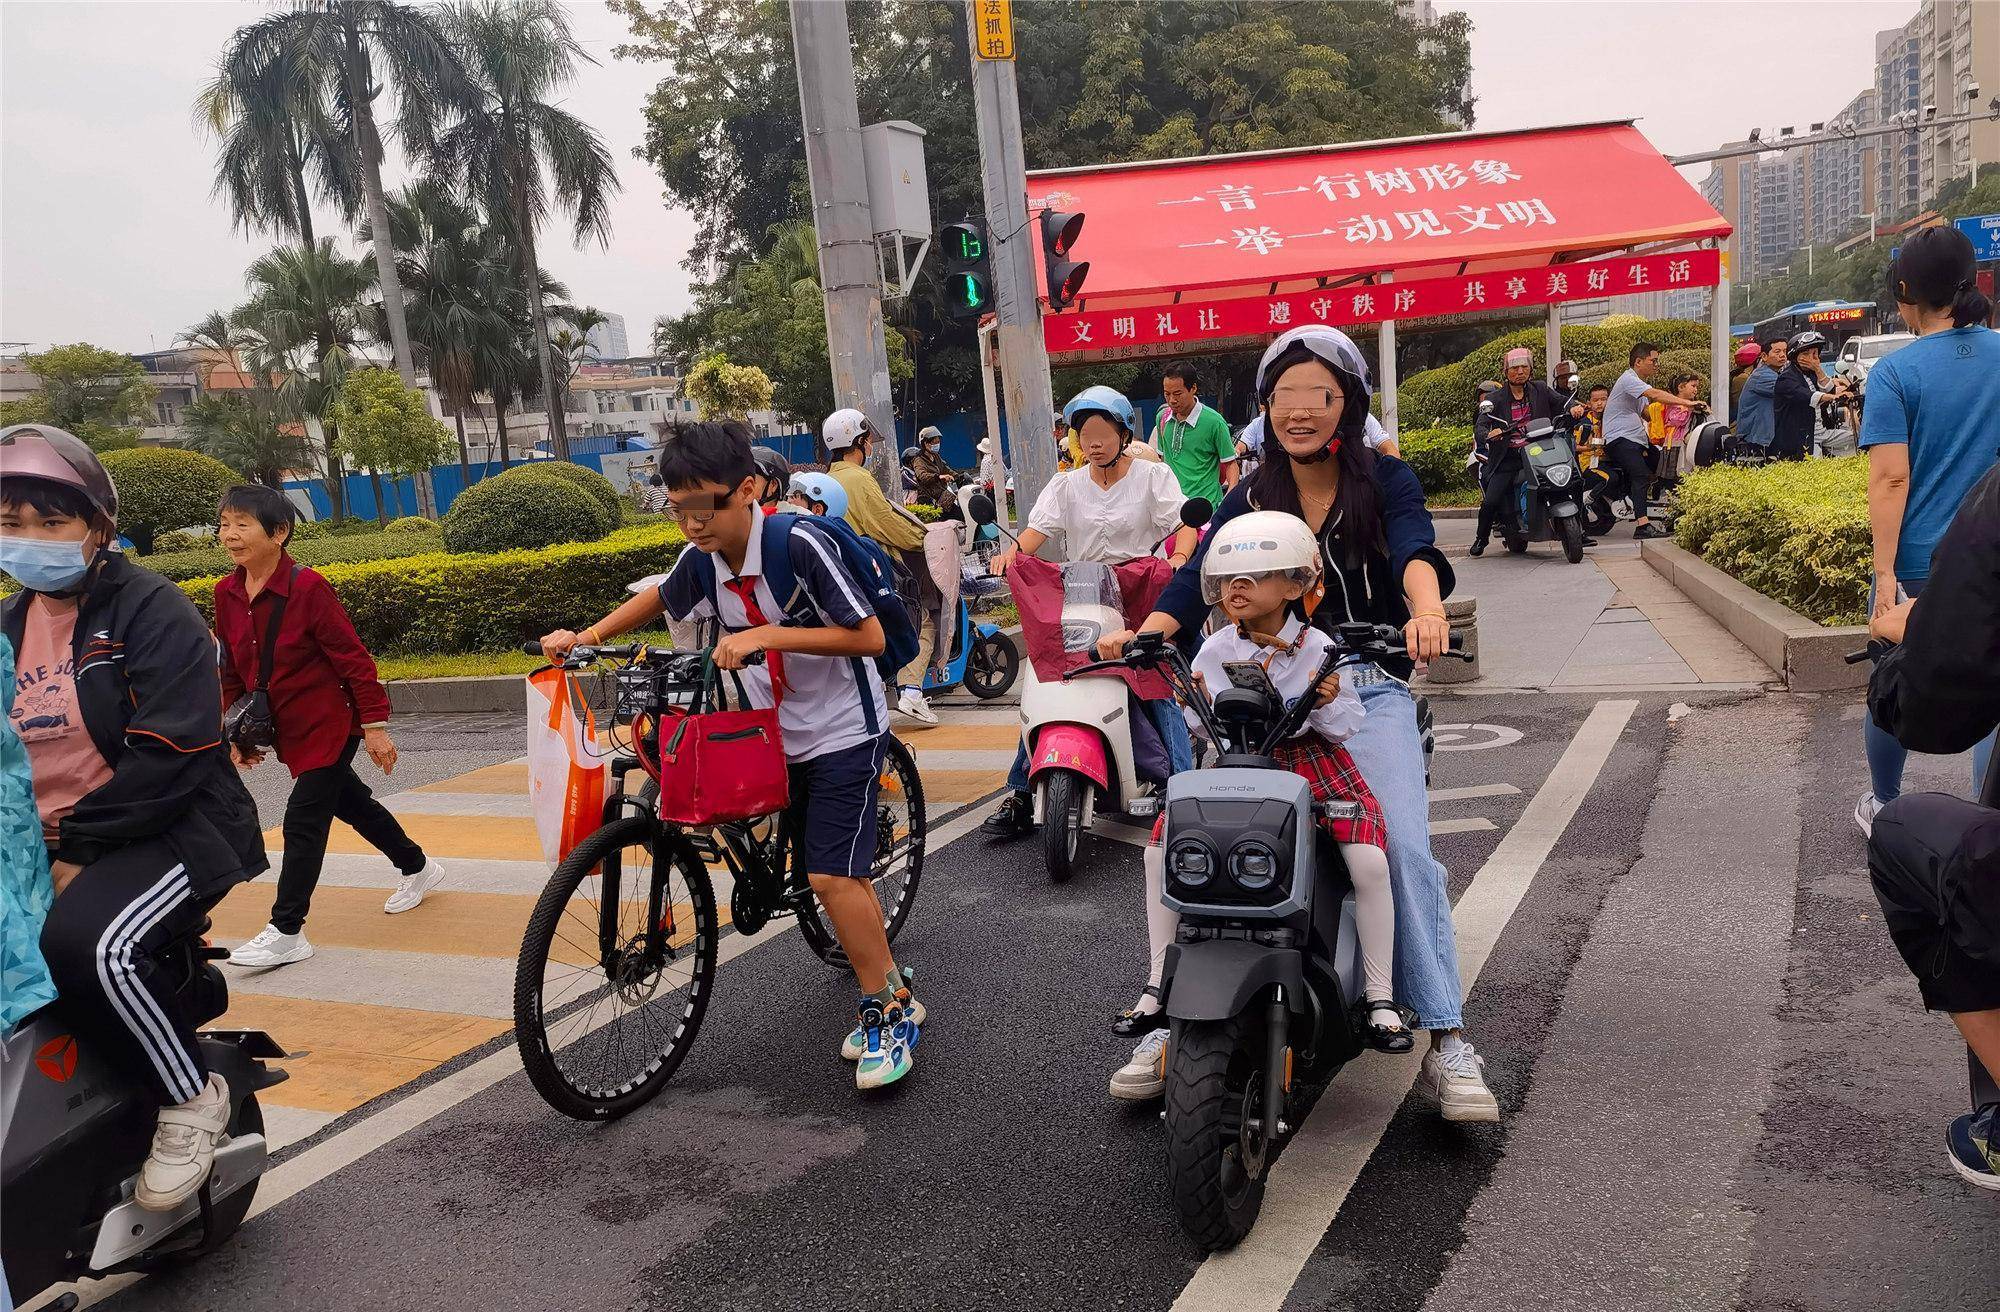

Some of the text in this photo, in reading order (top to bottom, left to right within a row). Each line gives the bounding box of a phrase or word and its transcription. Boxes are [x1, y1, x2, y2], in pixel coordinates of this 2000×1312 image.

[1157, 159, 1523, 213] 一言一行树形象
[1177, 198, 1558, 256] 一举一动见文明
[1071, 308, 1221, 344] 文明礼让
[1268, 288, 1417, 326] 遵守秩序
[1463, 259, 1691, 306] 共享美好生活
[15, 664, 49, 696] HE
